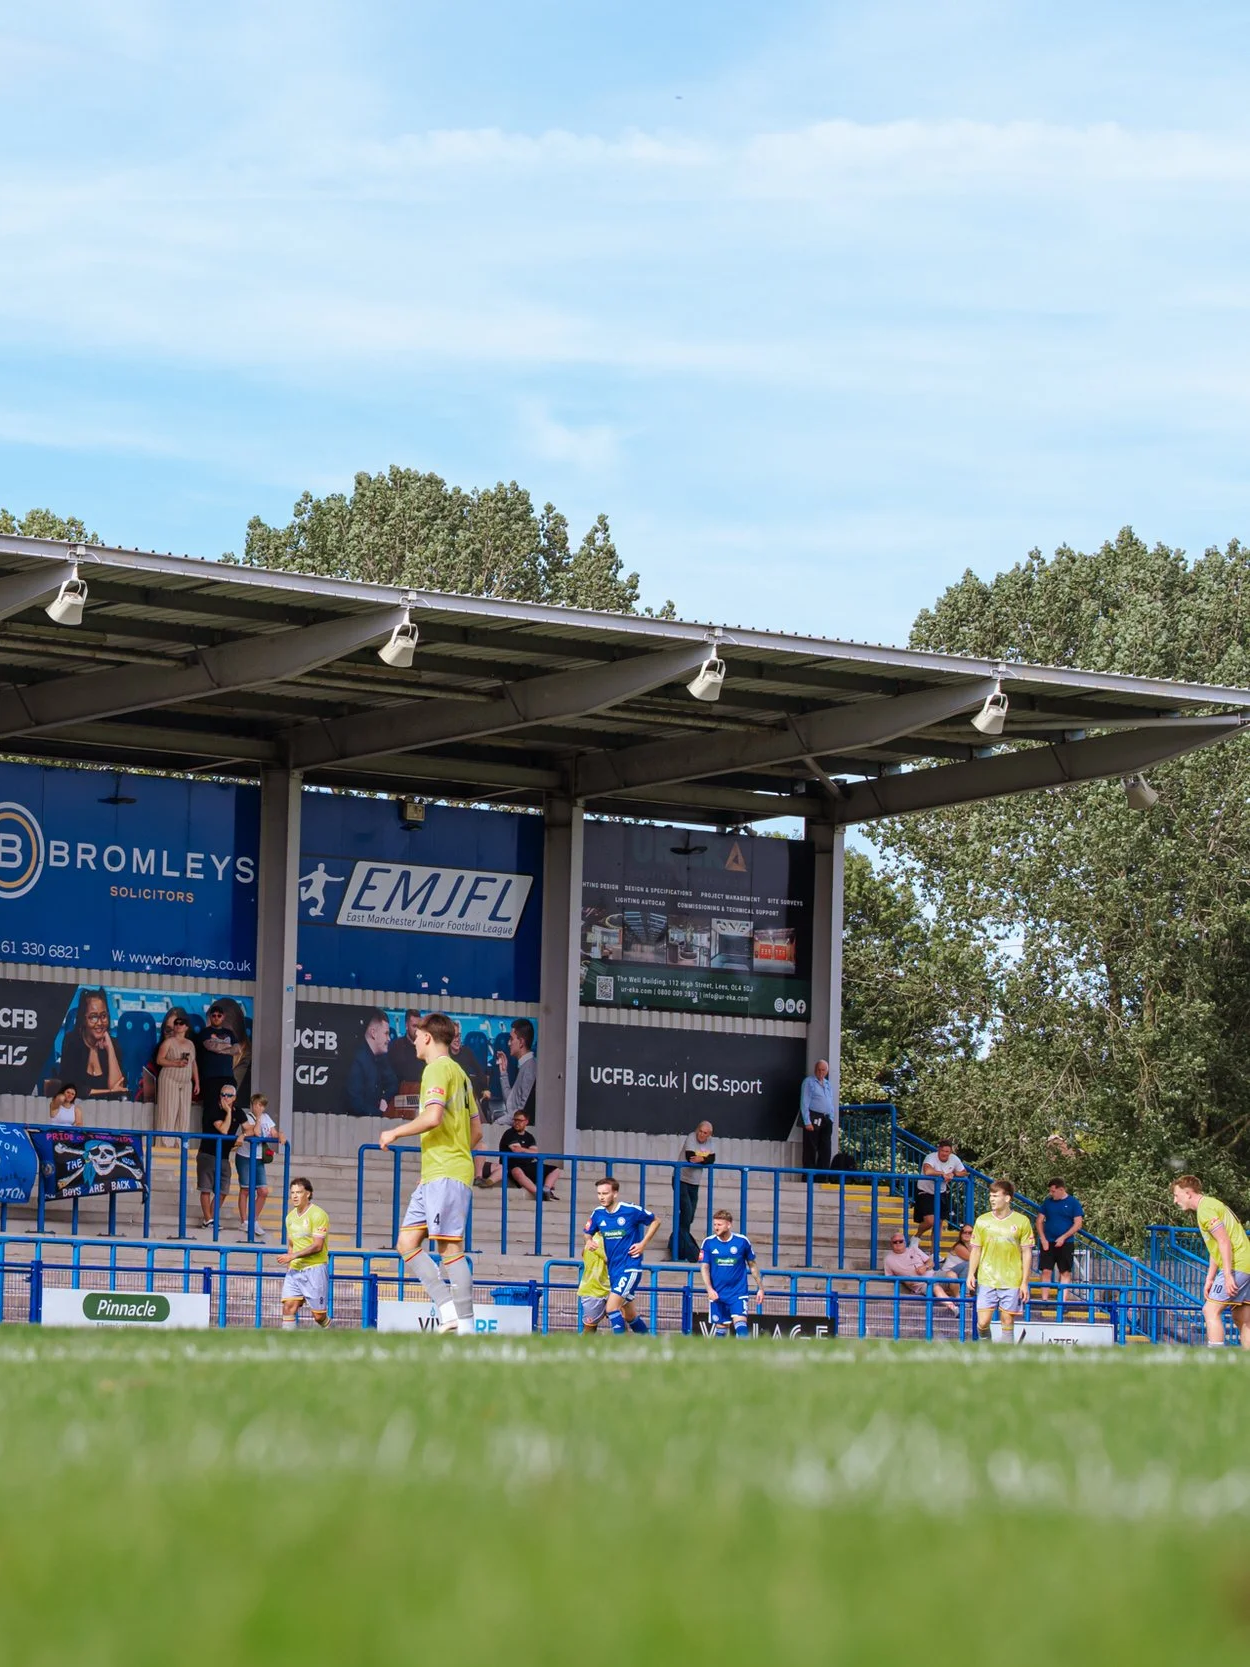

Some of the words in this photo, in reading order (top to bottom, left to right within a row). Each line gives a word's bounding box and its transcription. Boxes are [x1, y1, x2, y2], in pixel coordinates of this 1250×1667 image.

[49, 840, 255, 884] BROMLEYS
[110, 886, 194, 903] SOLICITORS
[351, 867, 512, 922] EMJFL
[624, 885, 644, 893] DESIGN
[650, 888, 693, 897] SPECIFICATIONS
[701, 892, 723, 900] PROJECT
[725, 894, 760, 903] MANAGEMENT
[781, 899, 804, 907] SURVEYS
[615, 897, 640, 905] LIGHTING
[642, 899, 666, 907] AUTOCAD
[677, 902, 720, 912] COMMISSIONING
[726, 906, 754, 914] TECHNICAL
[755, 909, 779, 917] SUPPORT
[346, 912, 365, 923] East
[367, 914, 416, 927] Manchester
[418, 919, 444, 929] Junior
[447, 921, 481, 933] Football
[483, 925, 512, 936] League
[21, 942, 46, 956] 330
[49, 945, 80, 959] 6821
[112, 950, 125, 962] W:
[129, 952, 251, 972] www.bromleys.co.uk
[295, 1065, 328, 1085] GIS
[590, 1066, 678, 1089] UCFB.ac.uk
[692, 1073, 762, 1097] GIS.sport
[46, 1132, 74, 1142] PRIDE
[66, 1159, 84, 1171] THE
[62, 1187, 82, 1198] BOYS
[89, 1183, 105, 1194] ARE
[111, 1180, 131, 1191] BACK
[433, 1213, 440, 1226] 4
[1213, 1284, 1223, 1294] 10
[97, 1299, 157, 1317] Pinnacle
